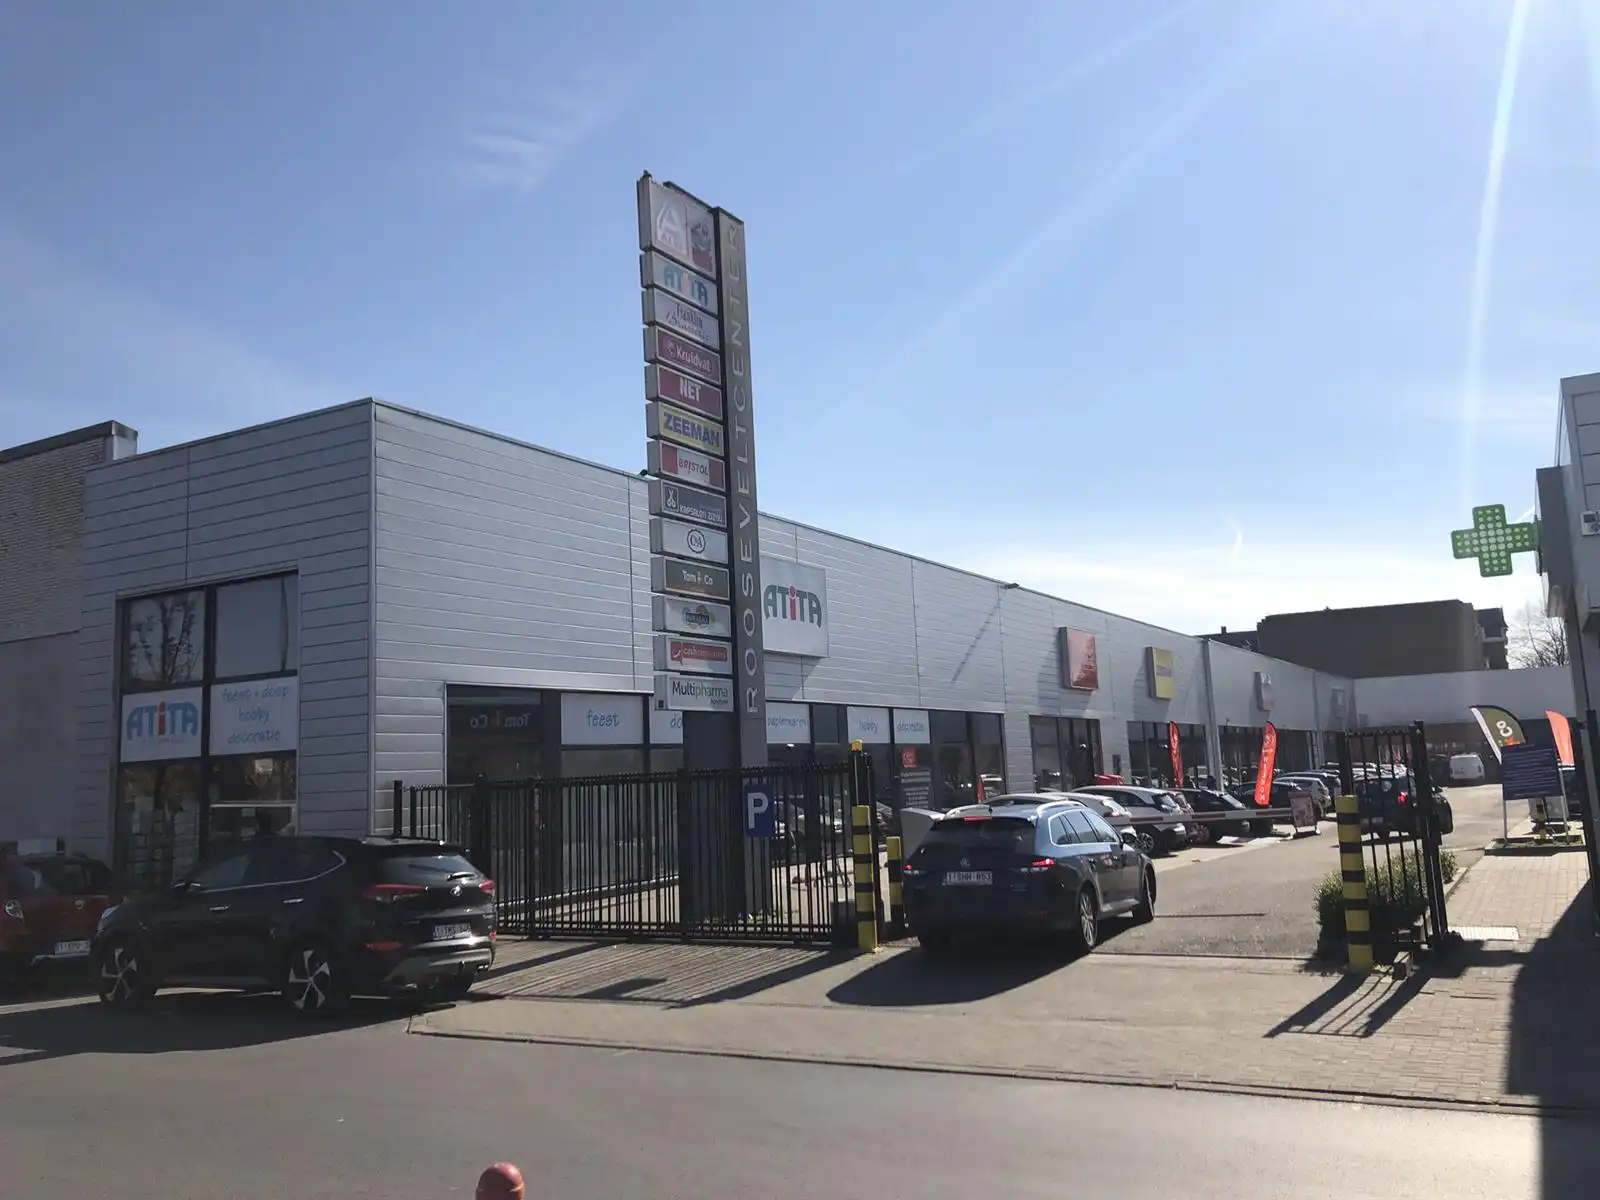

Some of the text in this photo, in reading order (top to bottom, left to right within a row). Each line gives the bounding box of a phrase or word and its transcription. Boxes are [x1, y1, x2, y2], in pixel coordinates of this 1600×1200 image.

[676, 345, 712, 373] Kruidvat
[679, 377, 702, 402] NET
[663, 411, 720, 448] ZEEMAN
[678, 458, 709, 476] BRISTOL
[682, 570, 697, 583] Tom
[703, 573, 714, 586] Co
[672, 680, 729, 699] Multipharma
[238, 705, 271, 724] hobby
[586, 708, 620, 729] feest
[747, 792, 769, 829] P
